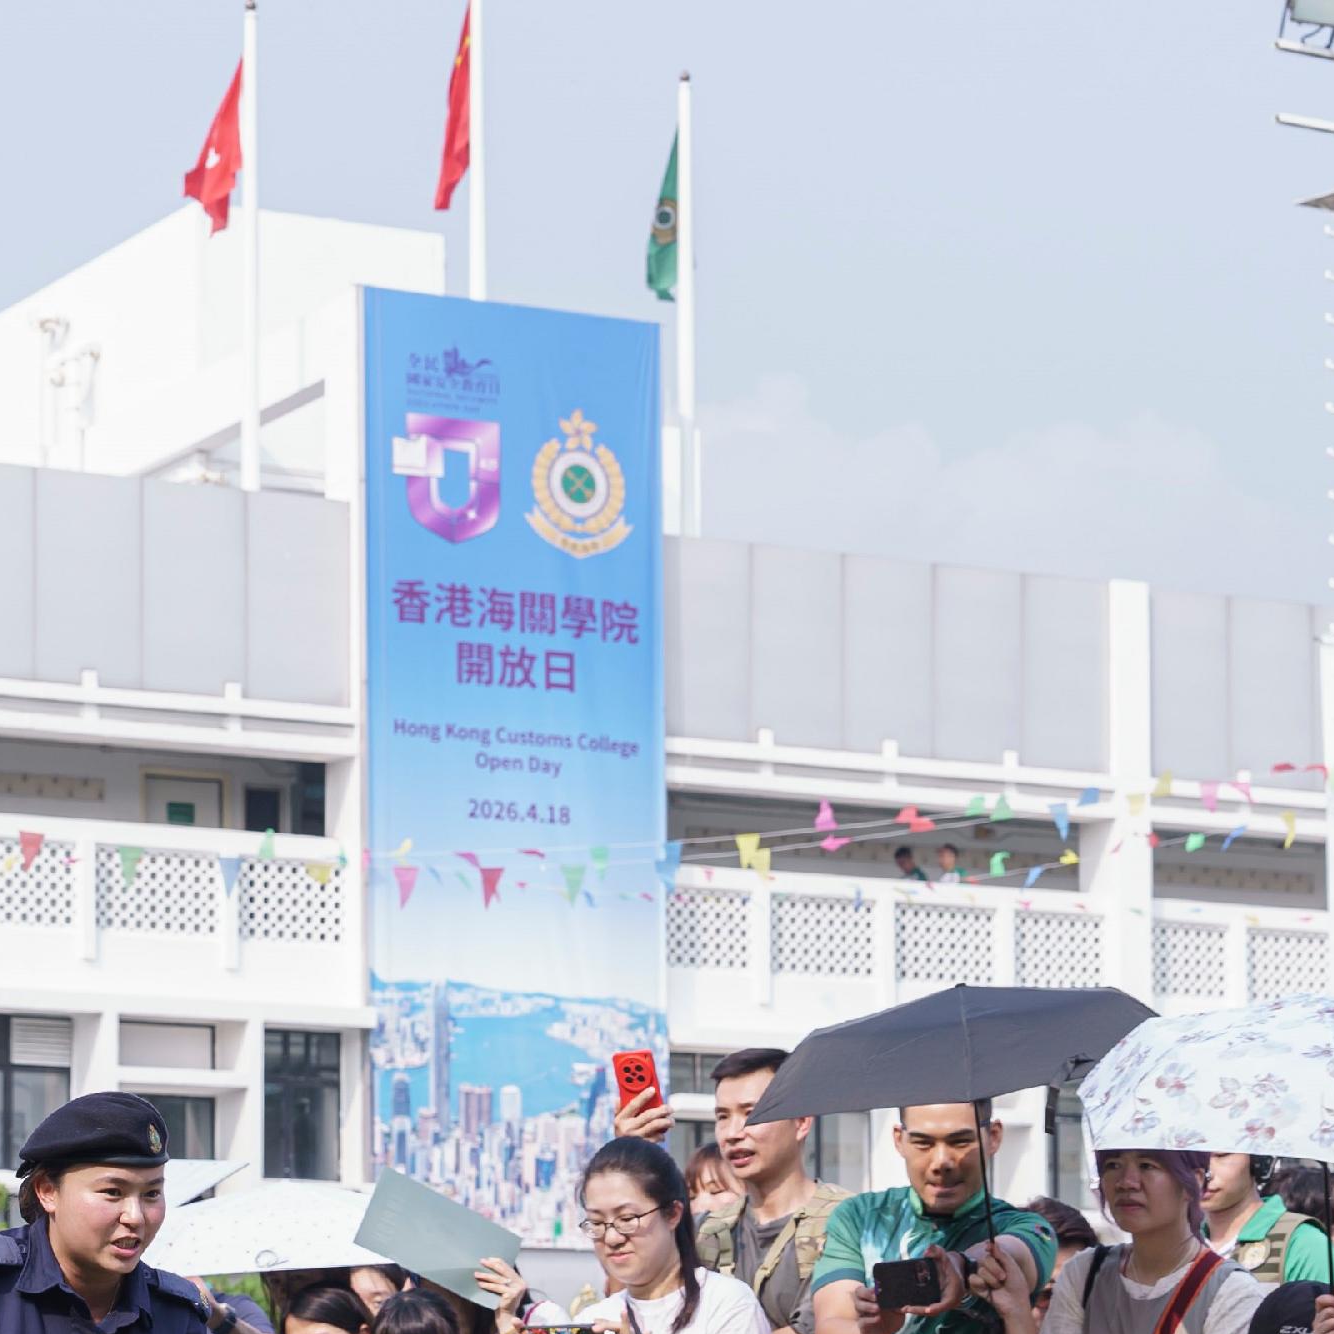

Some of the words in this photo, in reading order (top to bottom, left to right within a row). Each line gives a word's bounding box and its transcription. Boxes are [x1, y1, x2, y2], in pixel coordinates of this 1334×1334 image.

[392, 579, 641, 645] 香港海關學院
[456, 642, 577, 693] 開放日
[393, 718, 442, 743] Hong
[445, 724, 491, 746] Kong
[496, 727, 573, 750] Customs
[577, 734, 641, 757] College
[475, 752, 524, 776] Open
[529, 757, 563, 778] Day
[467, 799, 571, 826] 2026.4.18
